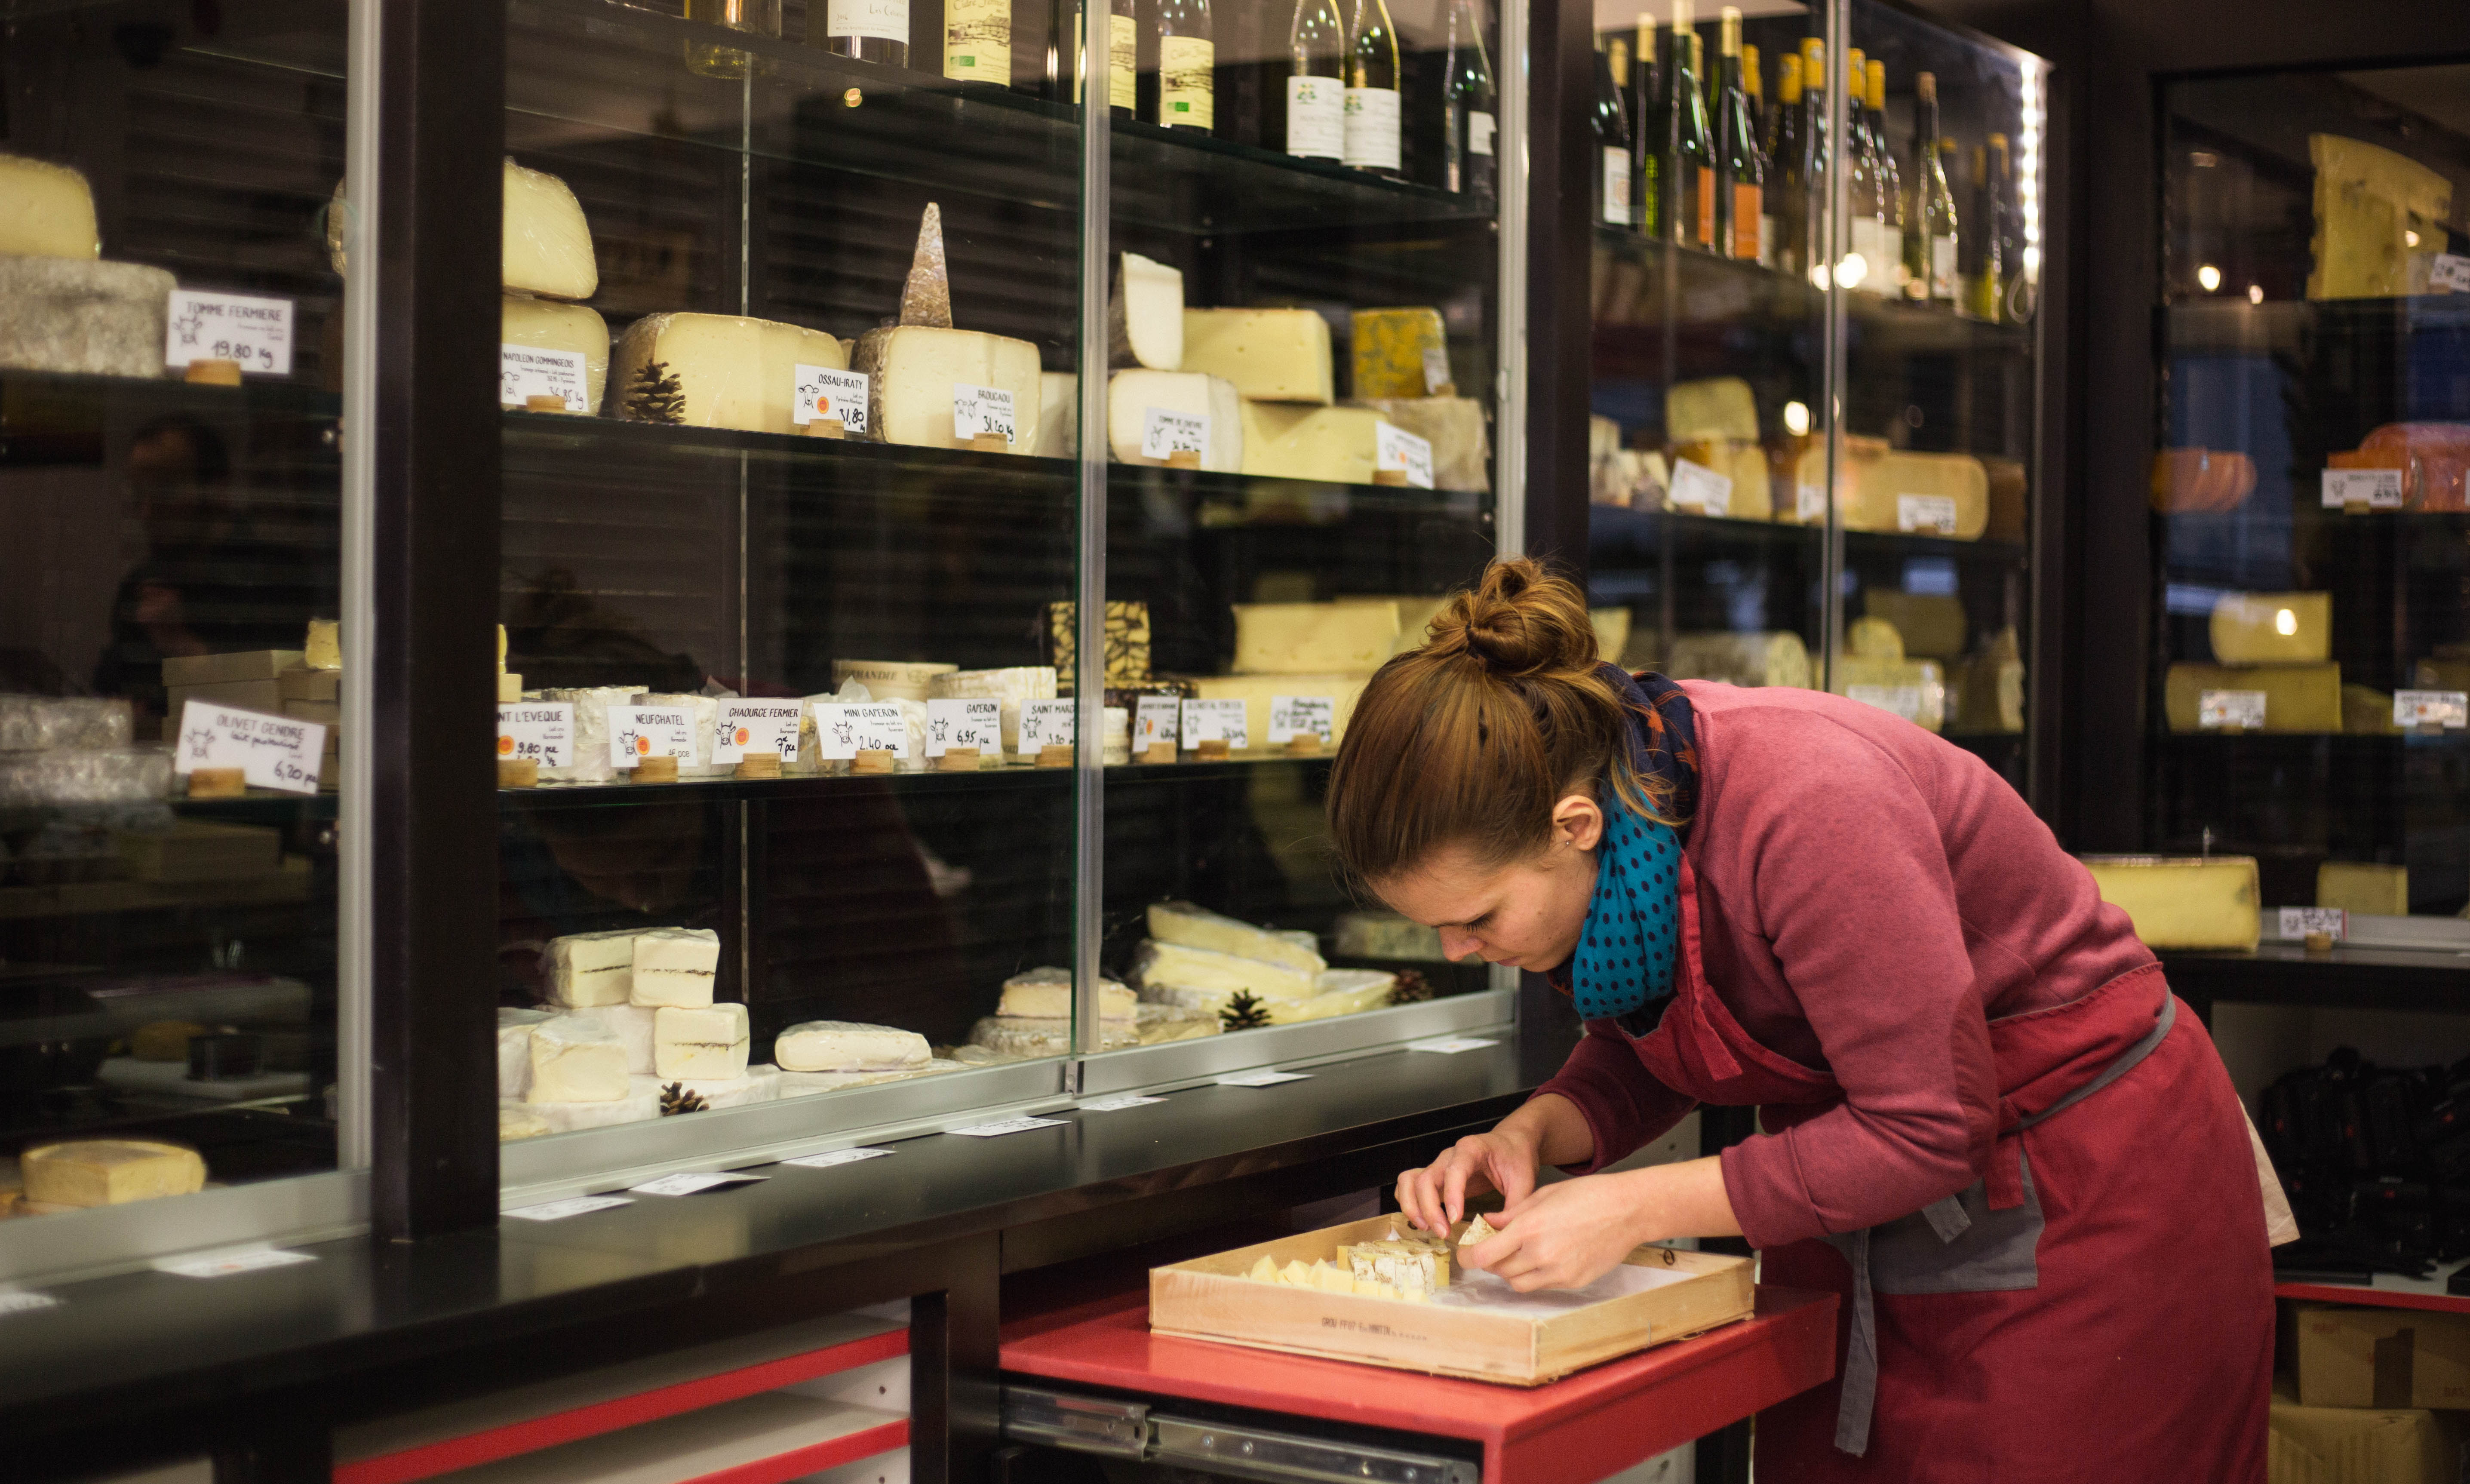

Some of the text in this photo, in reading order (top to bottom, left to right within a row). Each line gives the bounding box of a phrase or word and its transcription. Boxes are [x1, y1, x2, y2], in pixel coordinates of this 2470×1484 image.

[187, 301, 282, 321] TOMME FERMIERE
[212, 341, 252, 359] 19,80
[503, 352, 534, 363] NAPOLEON
[818, 374, 863, 389] OSSAU-IRATY
[729, 707, 799, 718] CHAOURCE FERMIER
[843, 708, 898, 718] MINI GAPERON
[966, 704, 997, 714] GAPERON
[1032, 705, 1053, 715] SAINT
[217, 714, 258, 731] OLIVET
[516, 710, 563, 722] L'EVEQUE
[636, 714, 685, 725] NEUFCHATEL
[957, 729, 977, 746] 6,95
[517, 741, 541, 755] 9,80
[274, 760, 302, 781] 6,20
